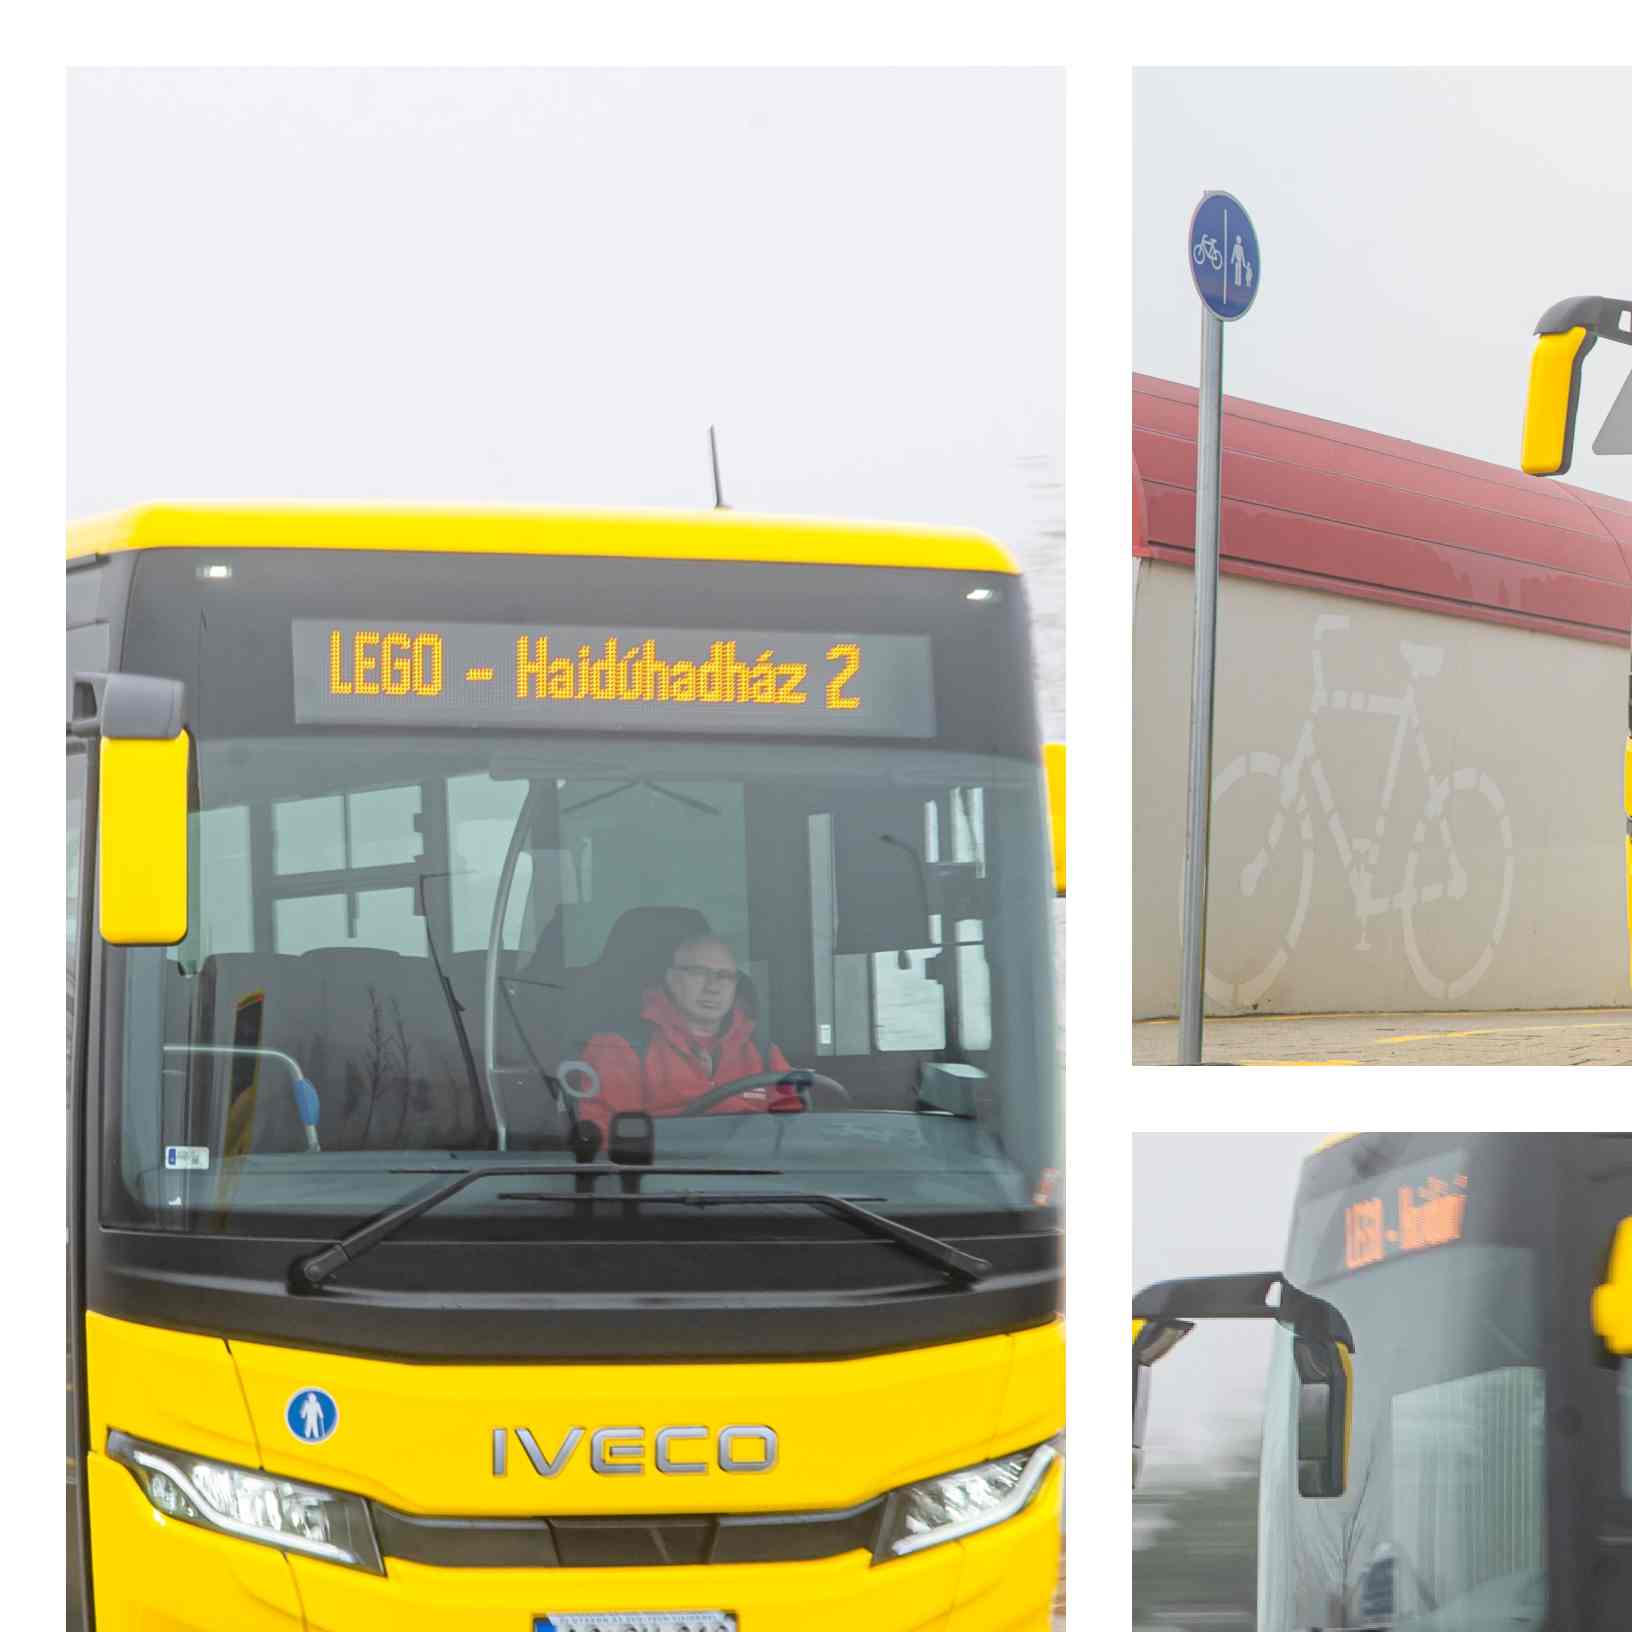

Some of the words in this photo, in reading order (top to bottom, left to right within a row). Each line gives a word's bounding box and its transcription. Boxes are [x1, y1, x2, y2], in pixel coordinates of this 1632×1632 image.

[329, 629, 443, 696] LEGO
[515, 635, 808, 705] Hajdúhadház
[825, 643, 861, 710] 2
[492, 1425, 779, 1479] IVECO
